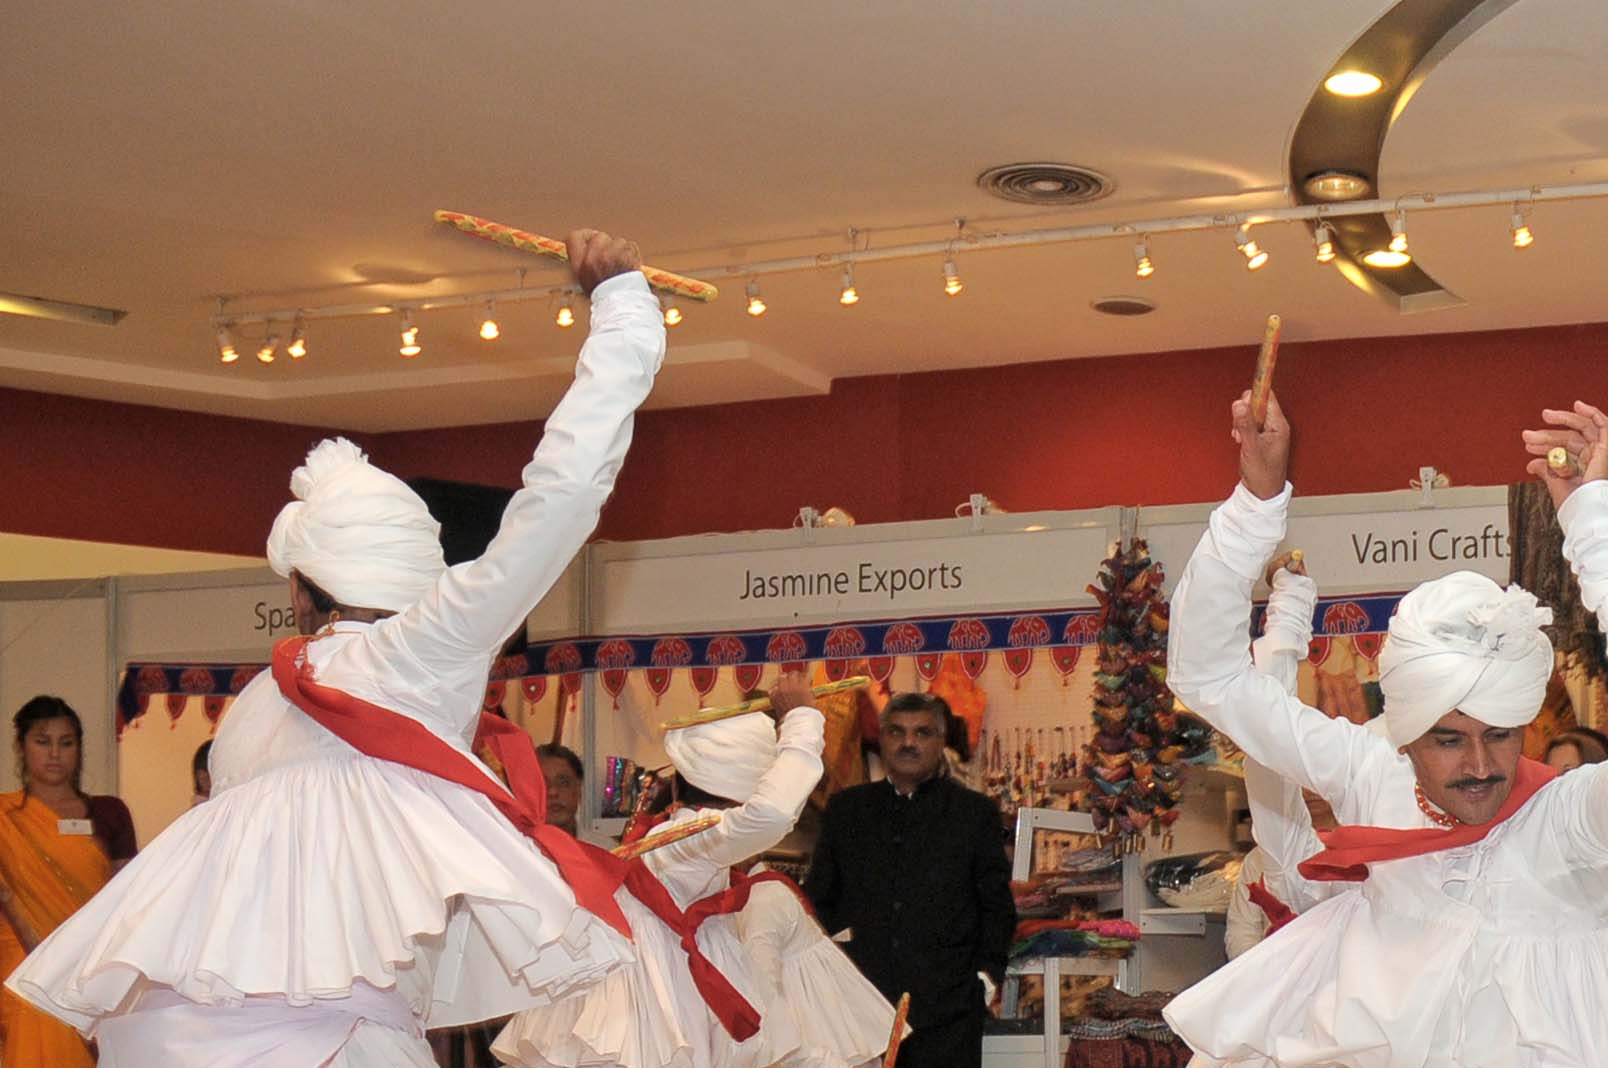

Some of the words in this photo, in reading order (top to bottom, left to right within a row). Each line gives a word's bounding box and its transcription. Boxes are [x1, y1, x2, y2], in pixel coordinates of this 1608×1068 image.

[1351, 530, 1418, 564] Vani
[739, 569, 849, 600] Jasmine
[858, 562, 963, 600] Exports
